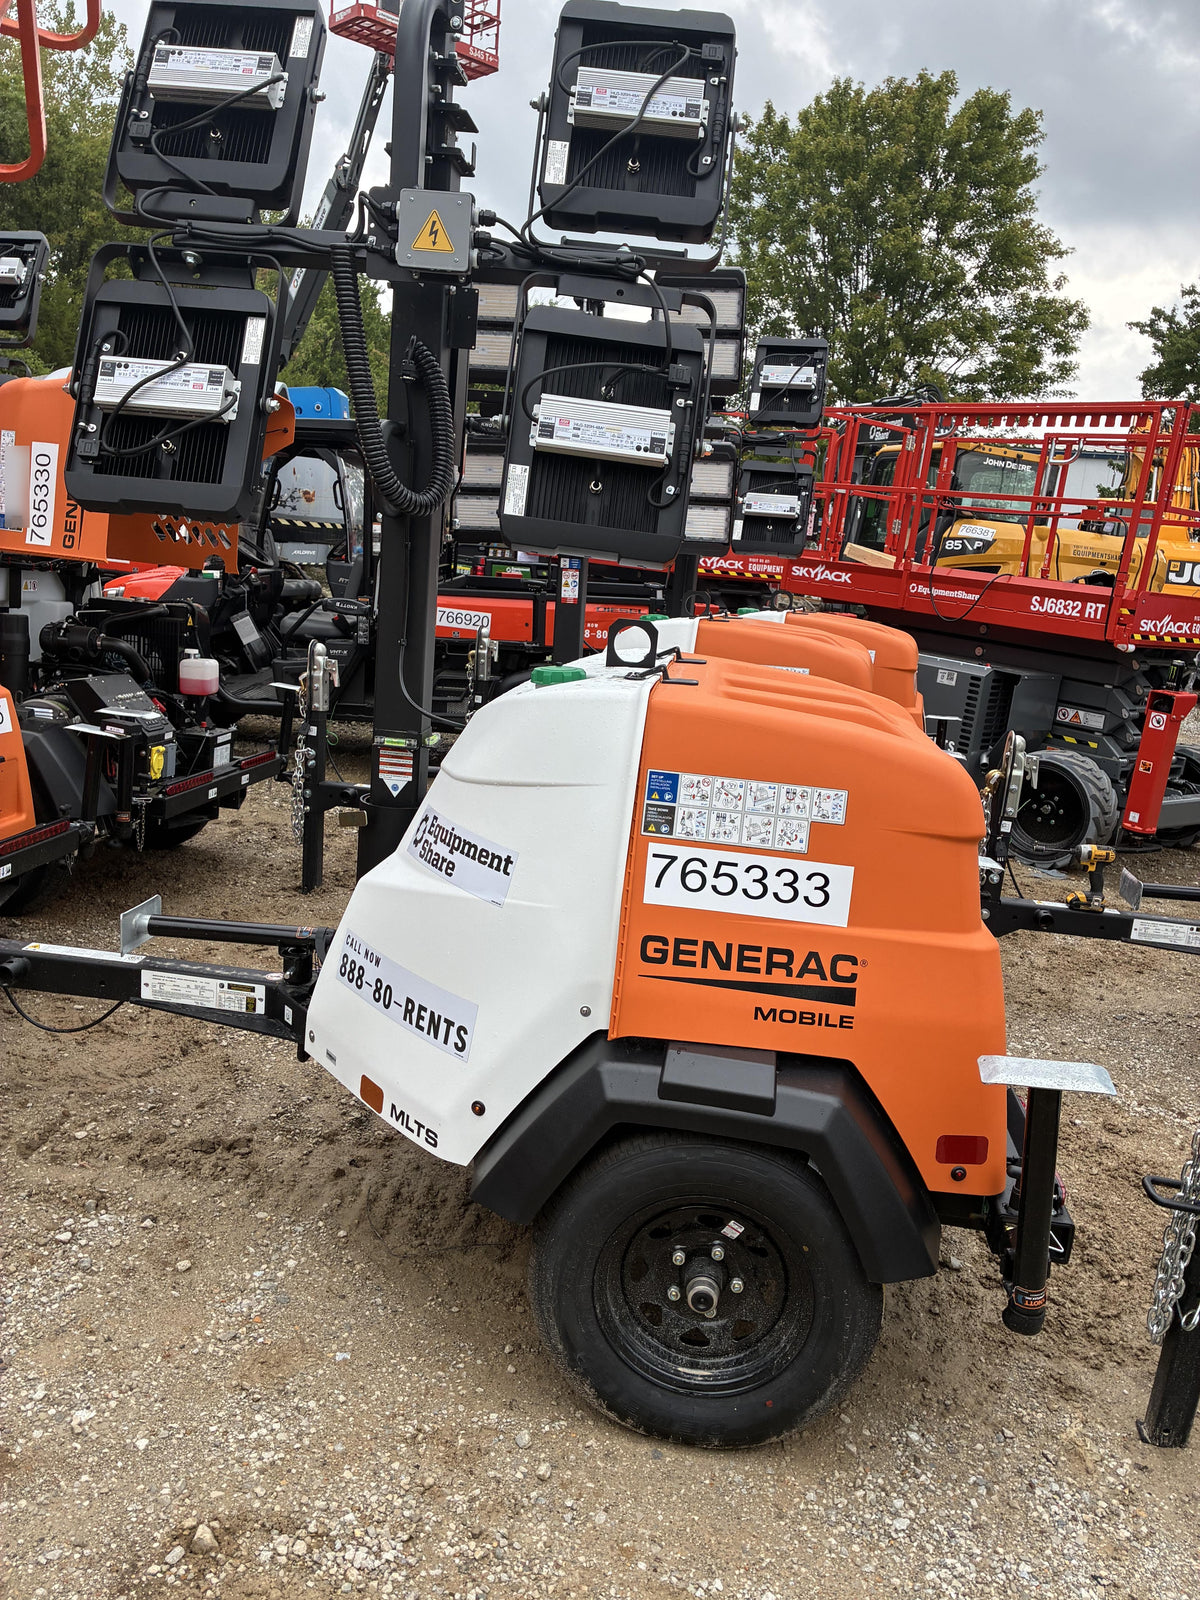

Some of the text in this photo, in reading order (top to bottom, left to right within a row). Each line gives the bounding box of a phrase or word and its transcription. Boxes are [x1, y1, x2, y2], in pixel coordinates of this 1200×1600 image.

[983, 456, 1005, 468] JOHN
[29, 453, 51, 542] 765330
[959, 525, 995, 539] 766381
[945, 540, 962, 550] 85
[699, 557, 744, 570] KYJACK
[749, 563, 784, 574] EQUIPMENT
[791, 564, 852, 584] SKYJACK
[438, 610, 490, 628] 766920
[1030, 595, 1106, 620] SJ6832 RT
[1139, 614, 1191, 635] SKYJACK
[427, 814, 514, 877] Equipment
[418, 838, 456, 878] Share
[651, 852, 831, 908] 765333
[345, 934, 382, 969] CALL NOW
[639, 934, 860, 984] GENERAC
[339, 953, 469, 1053] 888-80-RENTS
[753, 1006, 855, 1030] MOBILE
[389, 1103, 439, 1149] MLTS
